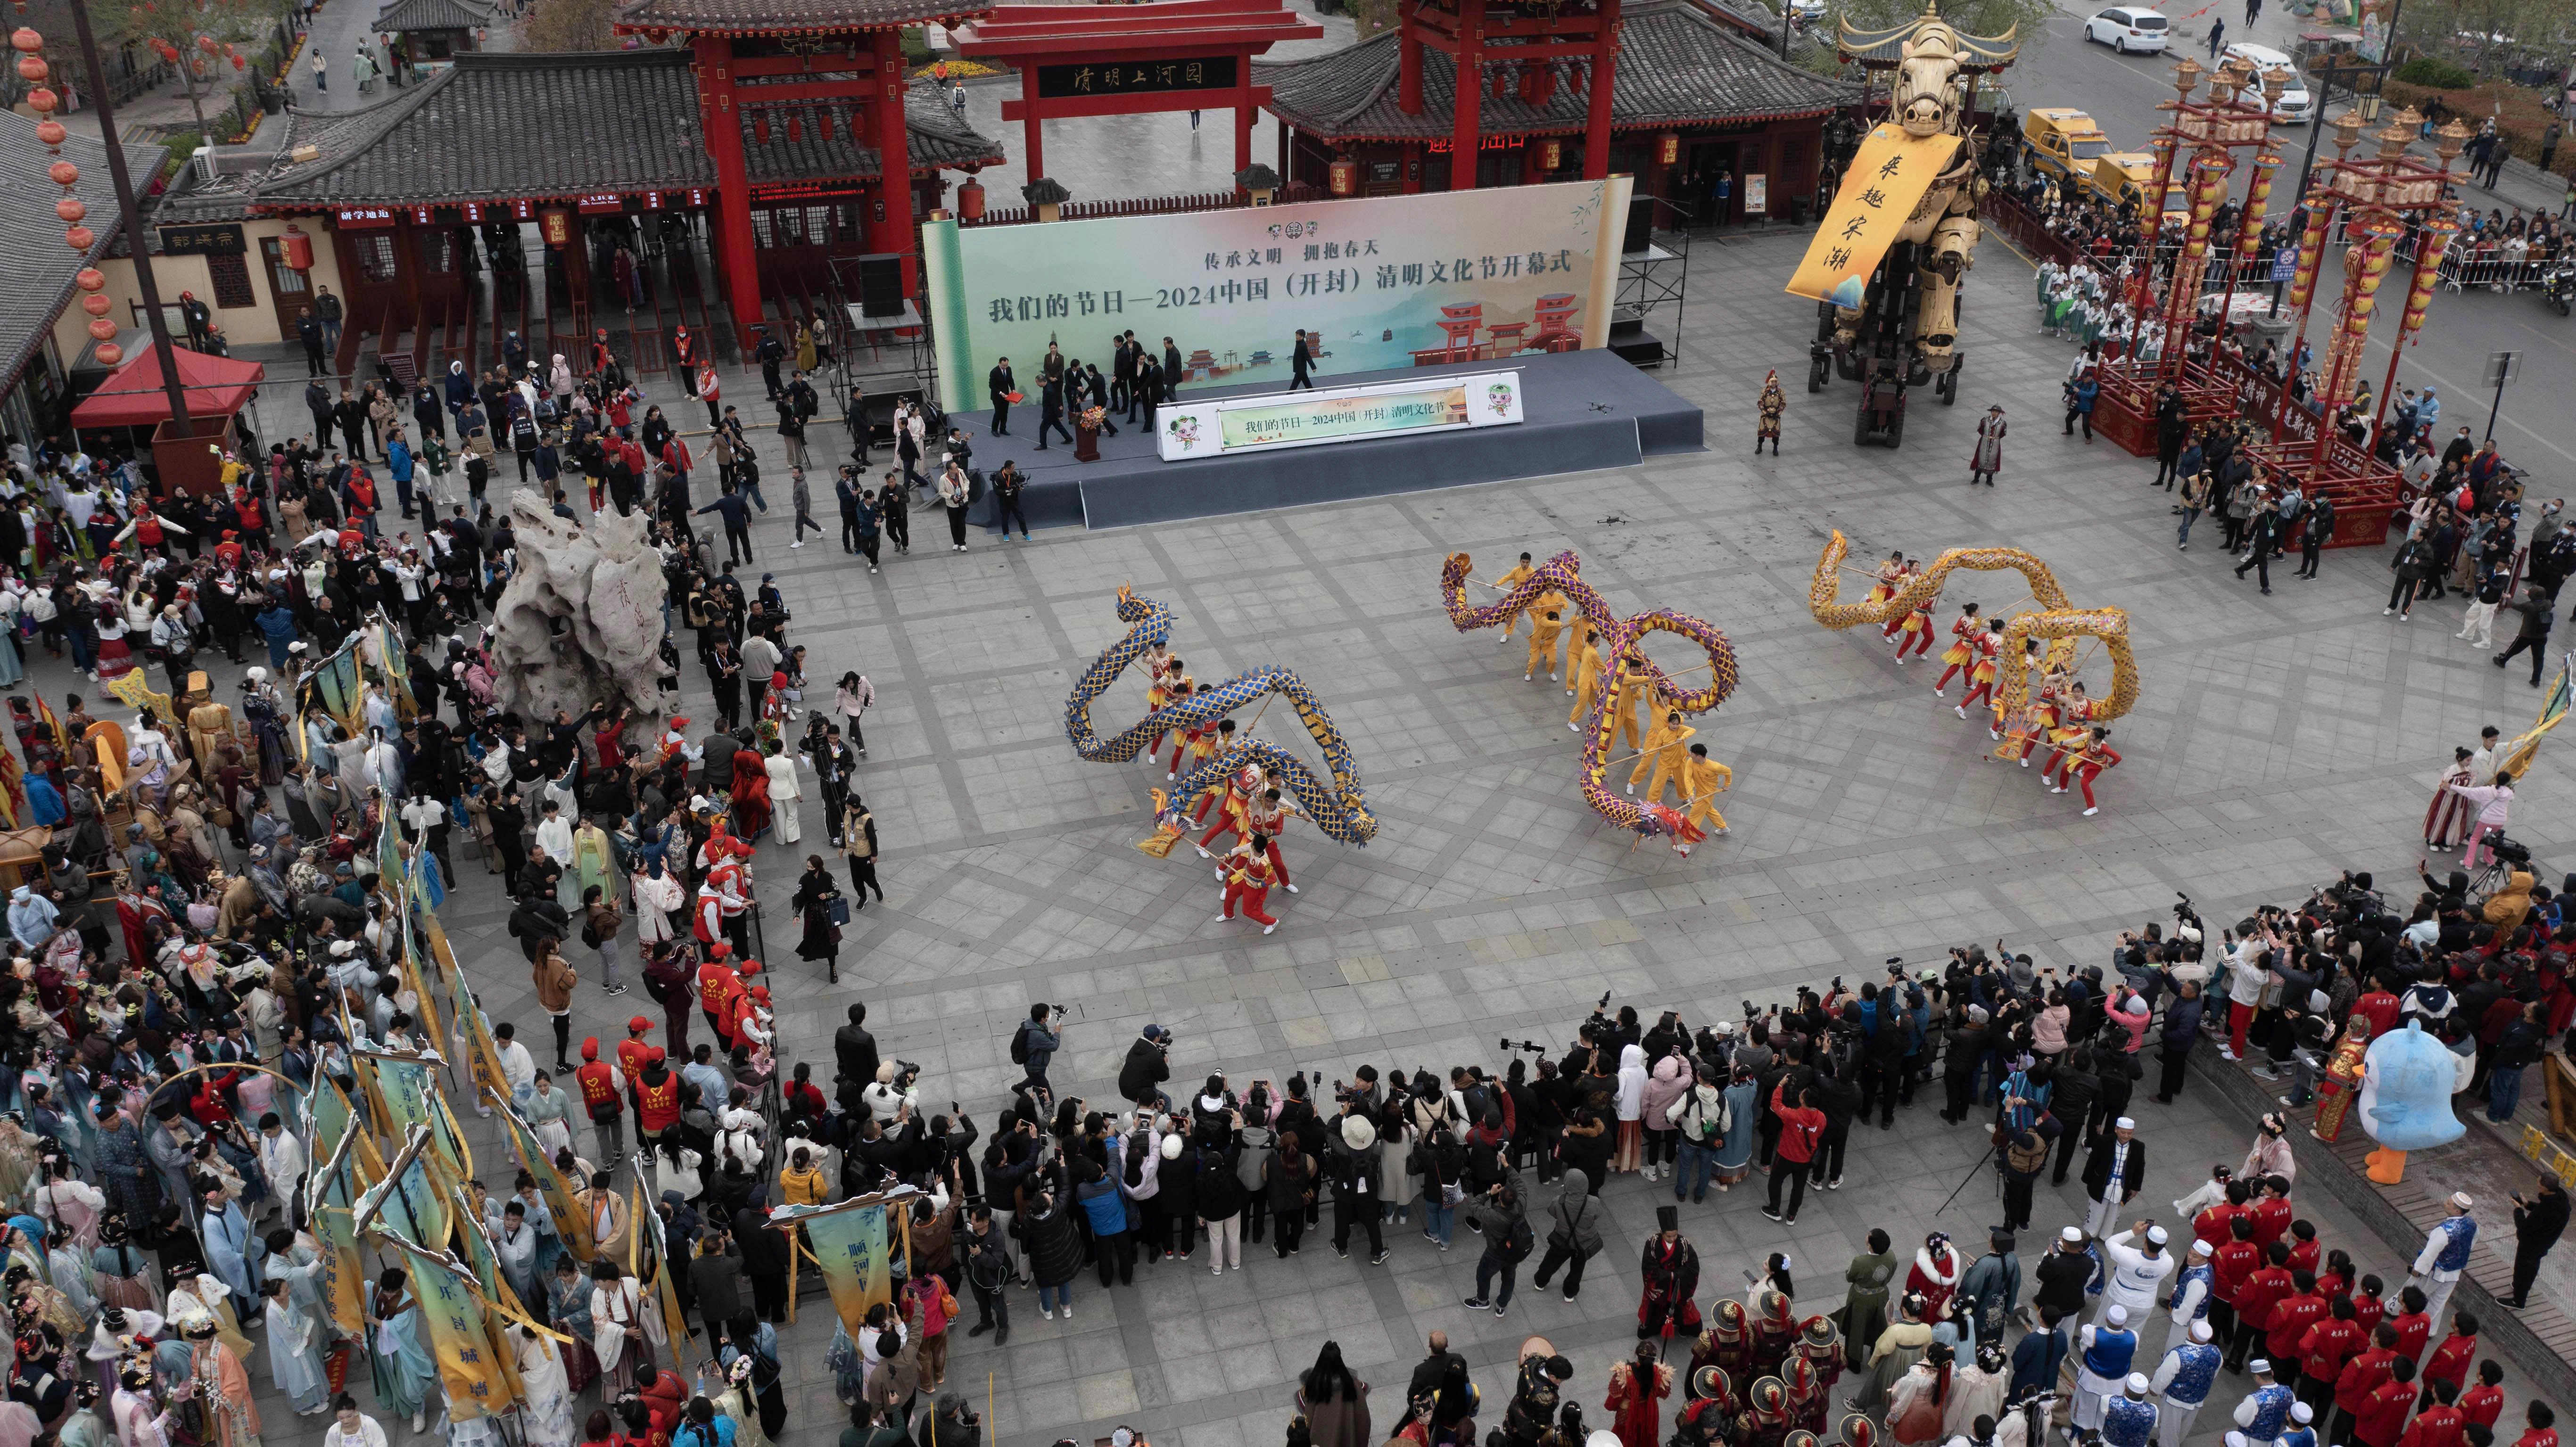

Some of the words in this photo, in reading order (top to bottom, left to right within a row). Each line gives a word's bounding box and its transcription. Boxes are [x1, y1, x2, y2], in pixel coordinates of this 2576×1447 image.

[1075, 63, 1202, 91] 清明上河园
[1205, 247, 1281, 270] 传承文明
[1304, 239, 1379, 262] 拥抱春天
[439, 1285, 488, 1397] 开封城墙
